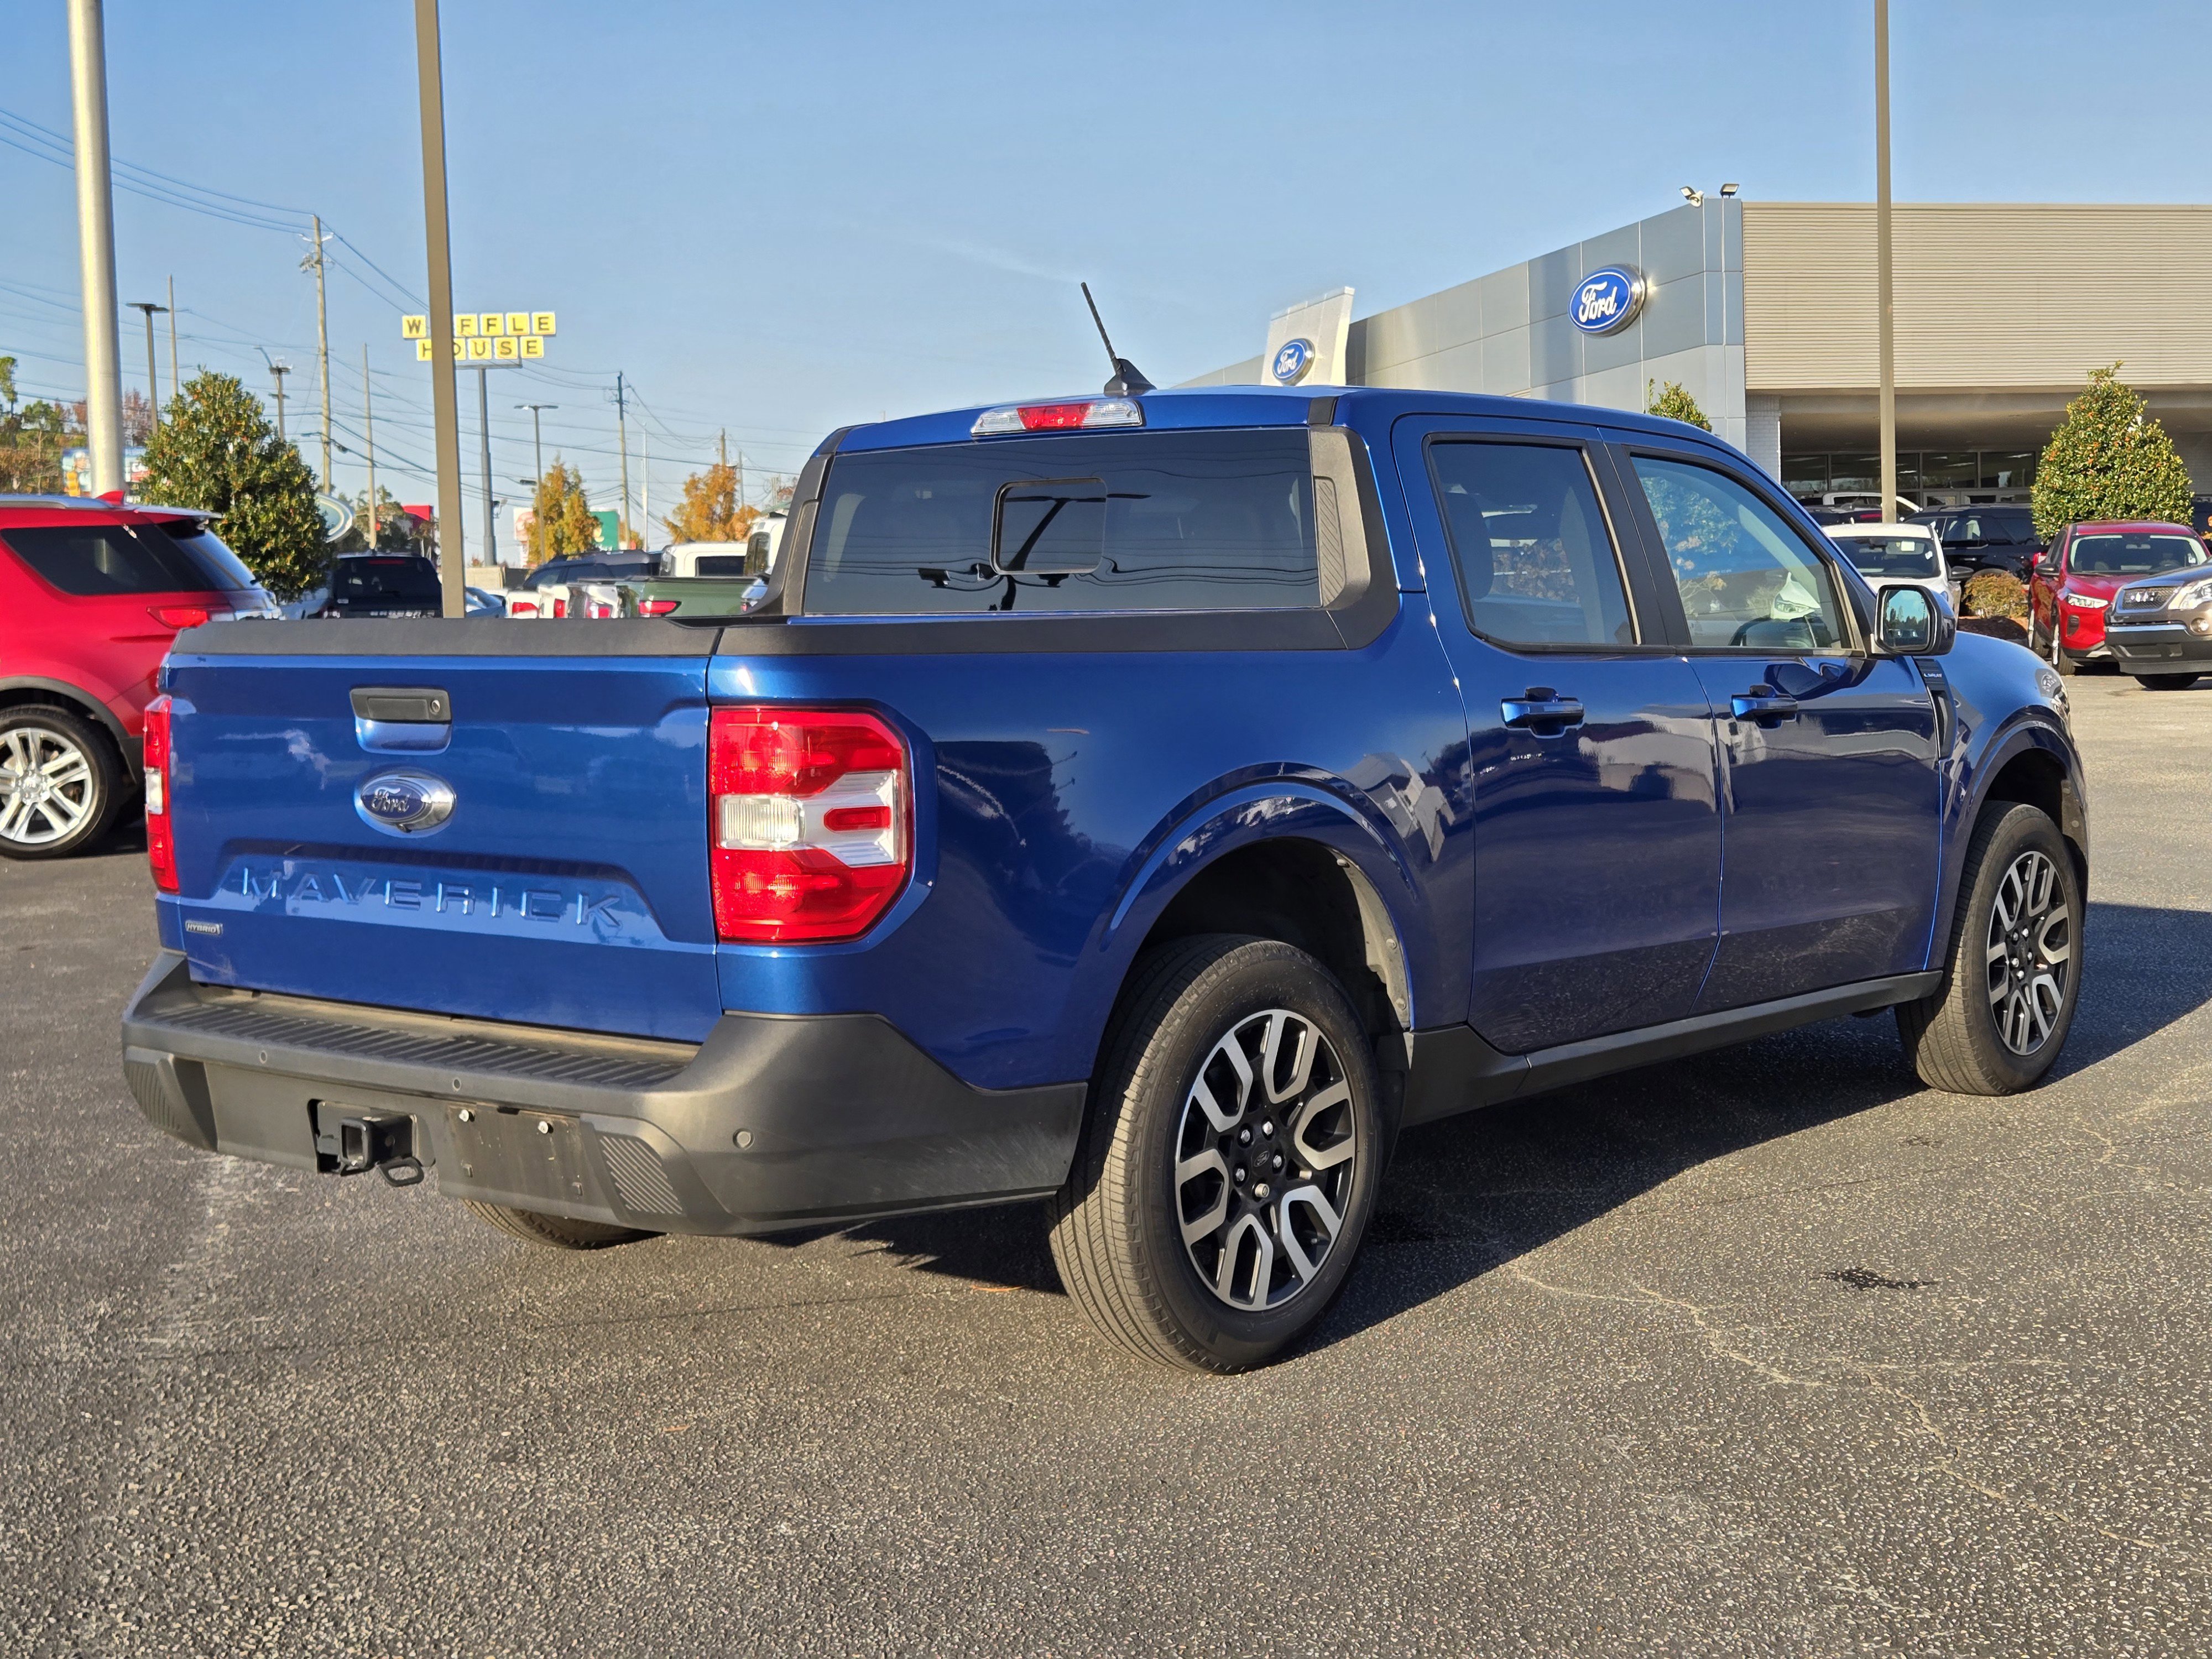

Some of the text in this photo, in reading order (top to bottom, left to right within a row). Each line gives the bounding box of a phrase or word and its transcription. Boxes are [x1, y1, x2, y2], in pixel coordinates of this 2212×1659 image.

[1578, 281, 1618, 322] Ford
[407, 316, 550, 334] WFFLE
[1277, 348, 1298, 374] Ford
[371, 786, 410, 812] Ford
[243, 867, 623, 930] MAVERICK
[187, 923, 216, 933] HYBRID
